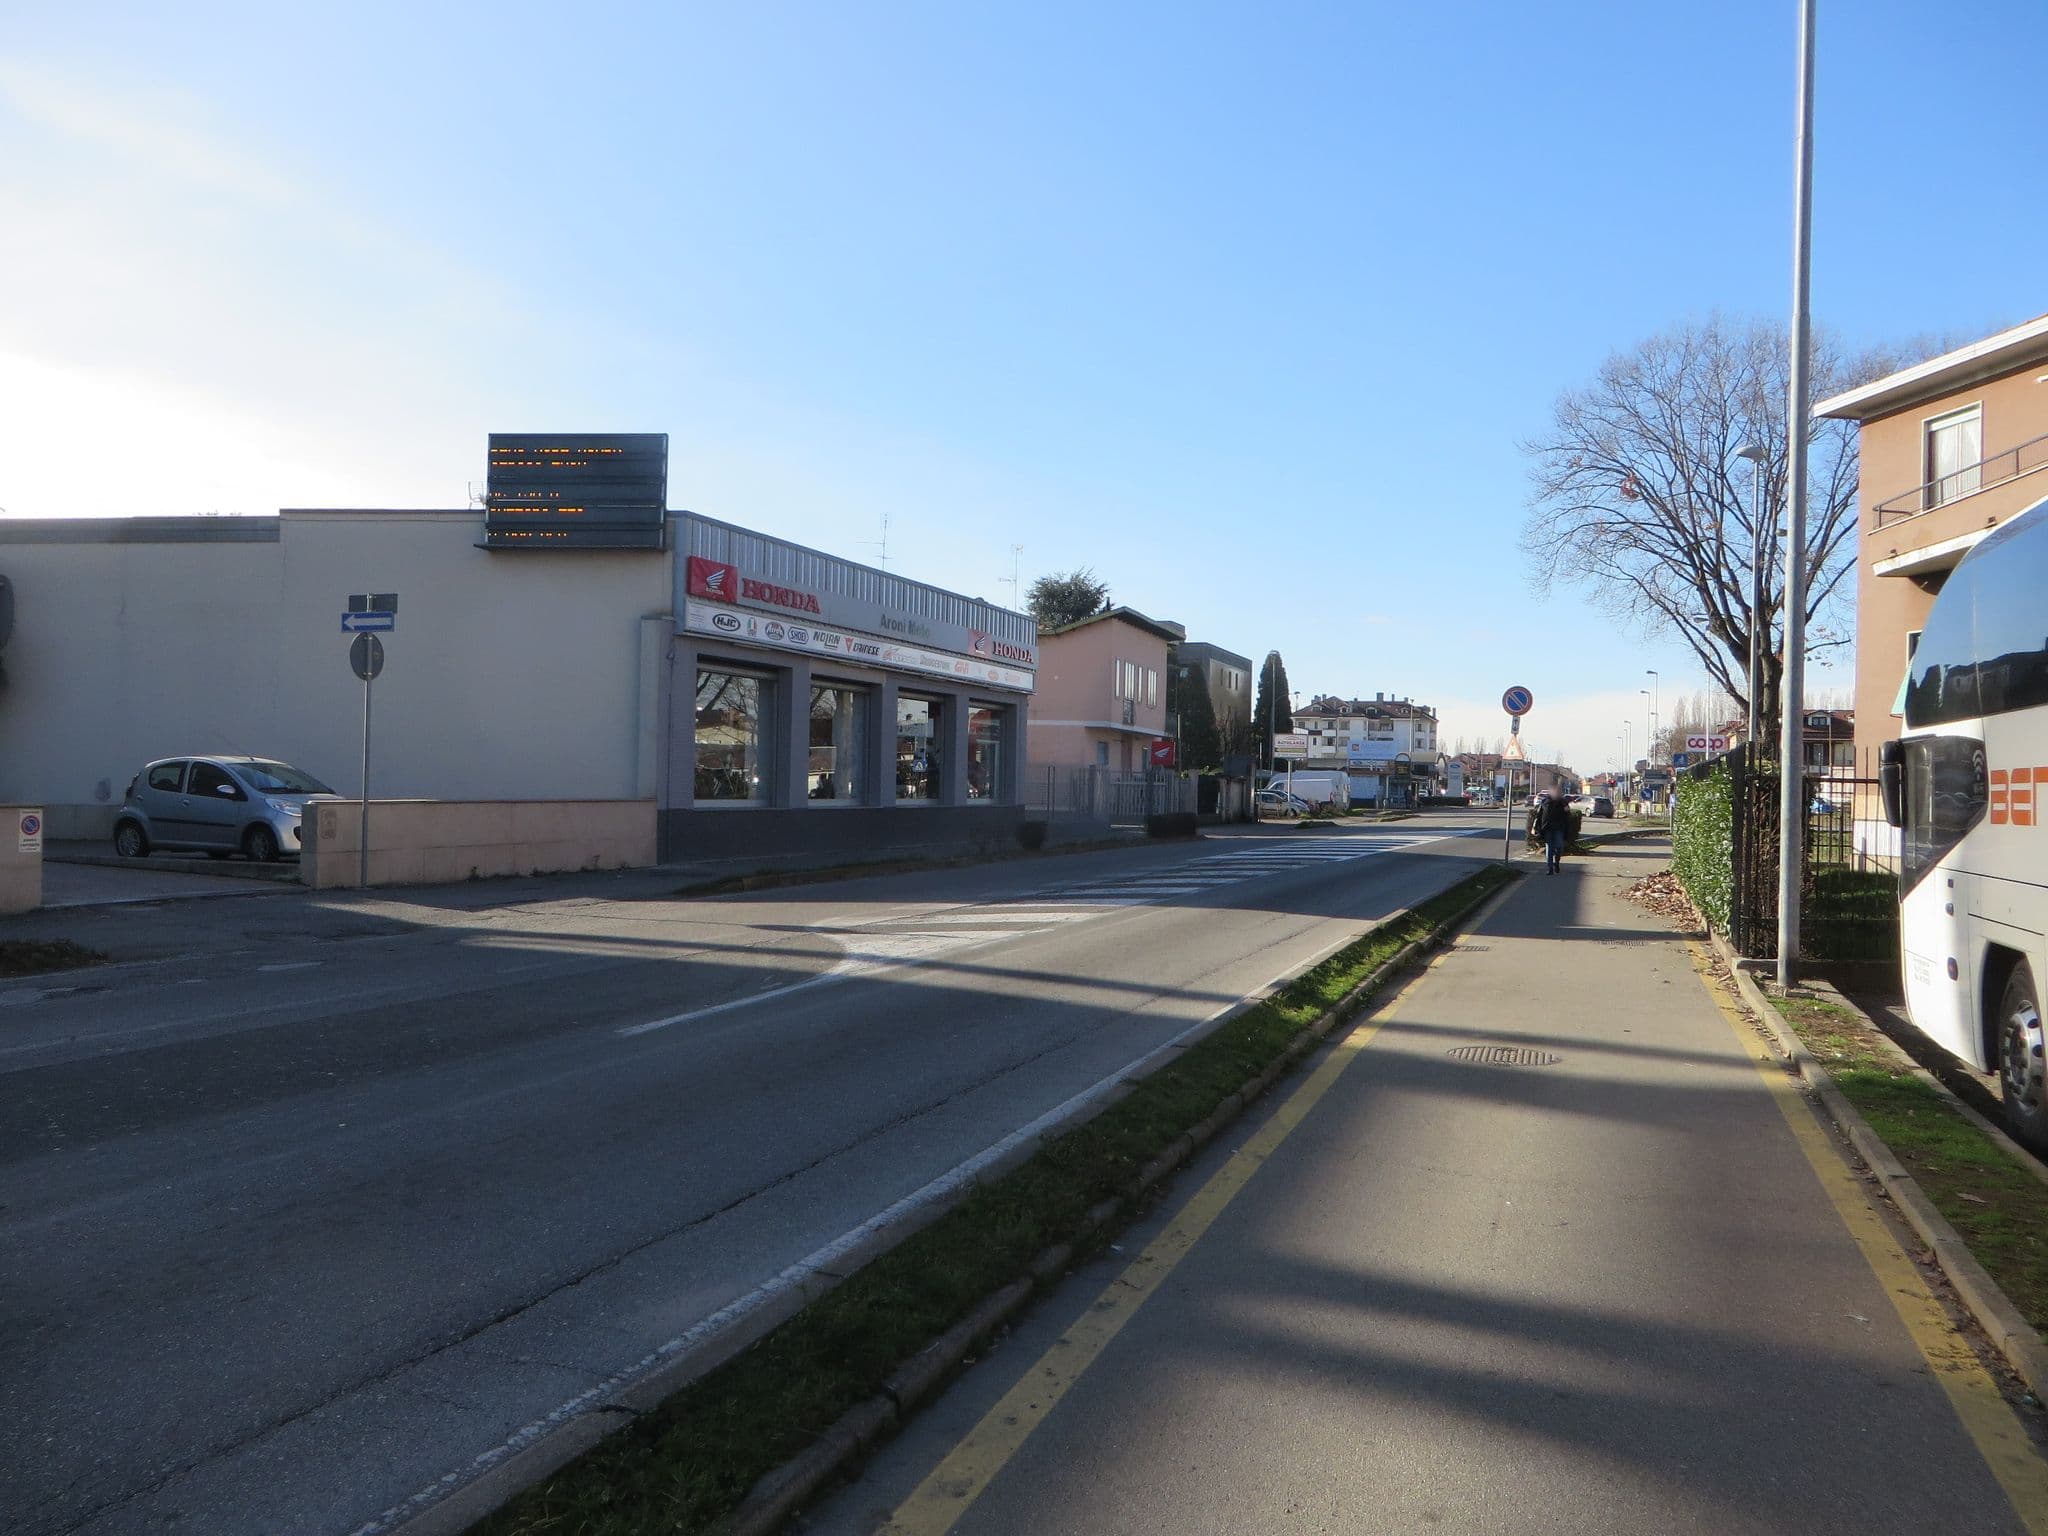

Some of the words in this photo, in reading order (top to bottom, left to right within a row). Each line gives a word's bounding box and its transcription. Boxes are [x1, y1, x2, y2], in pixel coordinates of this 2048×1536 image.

[742, 578, 821, 614] HONDA
[716, 616, 737, 628] HJC
[881, 613, 905, 633] Aroni
[813, 631, 840, 648] NOLAN
[993, 641, 1034, 662] HONDA
[1688, 738, 1723, 751] coop
